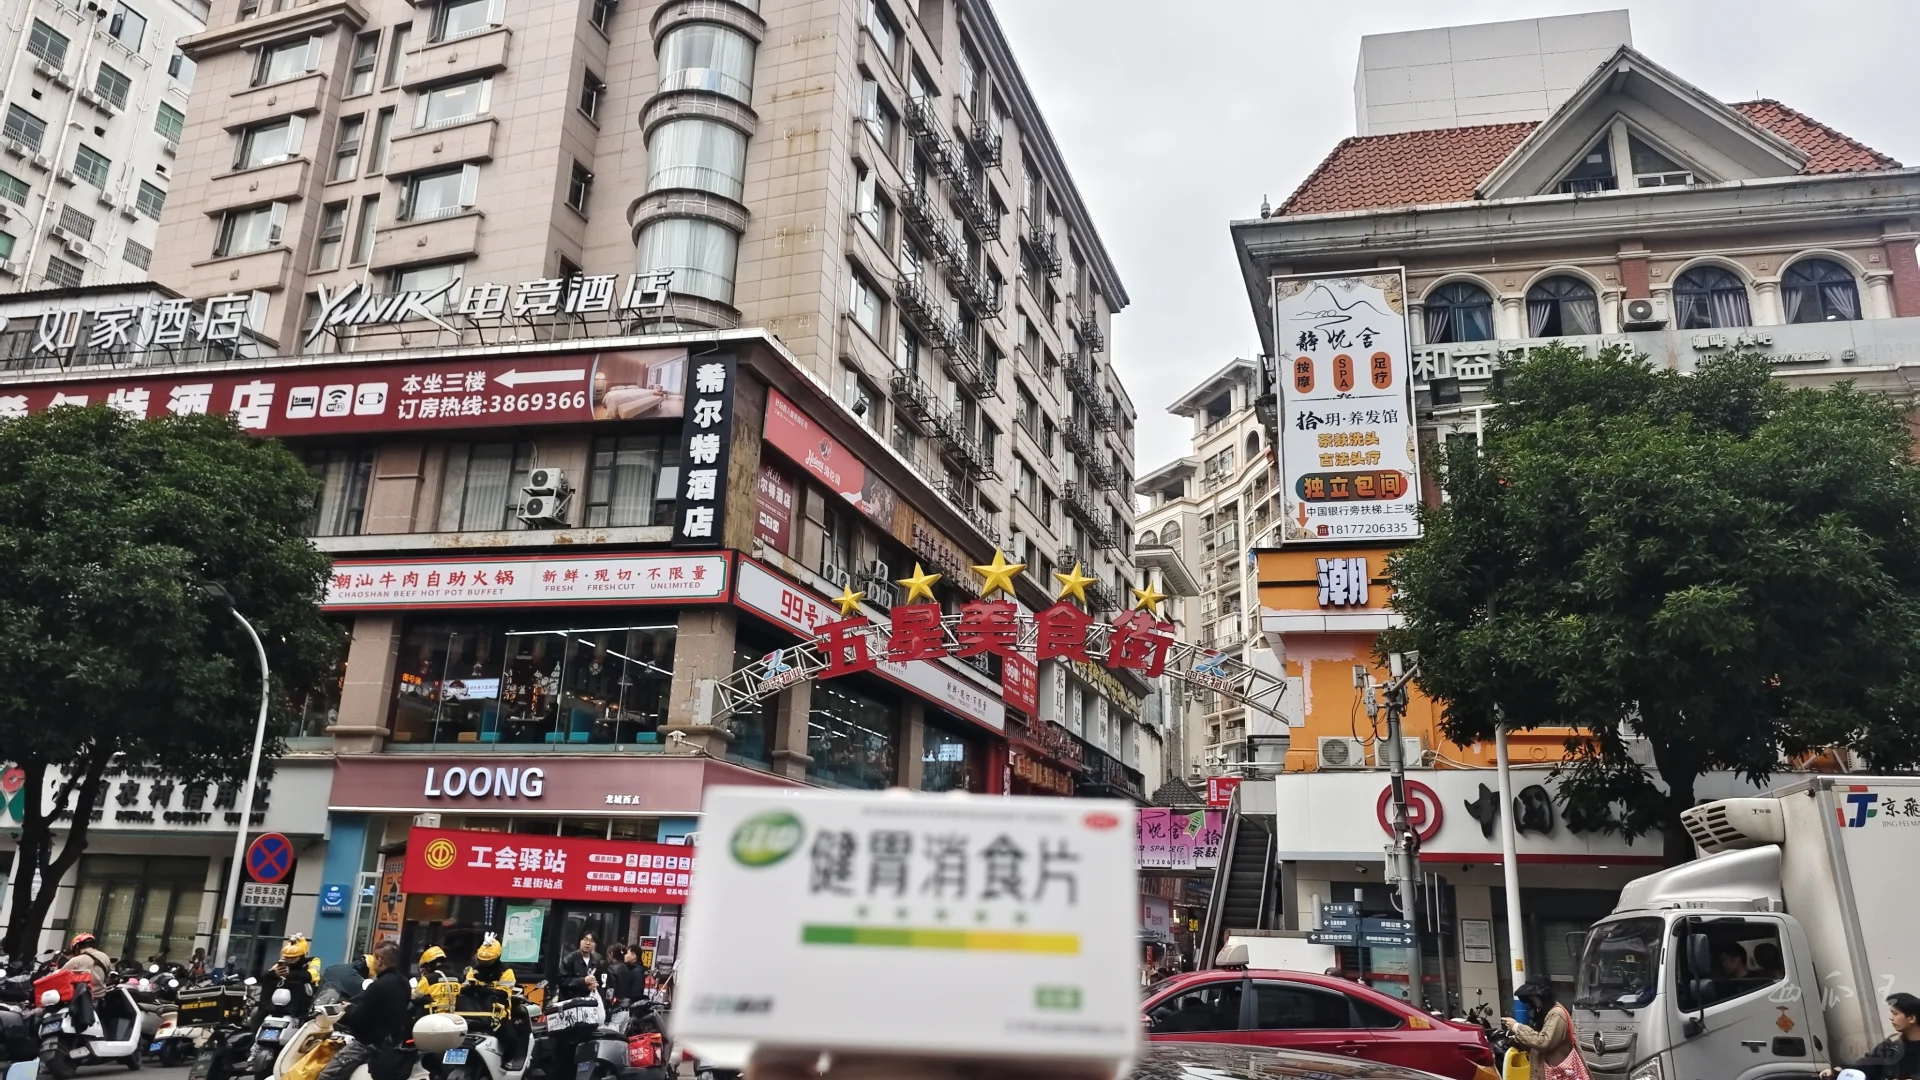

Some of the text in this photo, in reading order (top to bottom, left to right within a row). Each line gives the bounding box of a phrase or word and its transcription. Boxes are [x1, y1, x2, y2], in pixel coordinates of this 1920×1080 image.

[458, 270, 675, 320] 电竞酒店
[32, 293, 251, 353] 如家酒店
[1296, 327, 1380, 352] 静悦舍
[1692, 332, 1773, 349] 咖啡 餐吧
[1296, 362, 1314, 389] 按摩
[1338, 358, 1349, 389] SPA
[1373, 357, 1389, 385] 足疗
[402, 371, 486, 395] 本坐三楼
[397, 391, 586, 420] 订房热线:3869366
[683, 363, 726, 538] 希尔特酒店
[1317, 431, 1380, 448] 茶麸洗头
[1319, 450, 1381, 468] 古法头疗
[1303, 473, 1401, 499] 独立包间
[1306, 503, 1414, 518] 中国银行旁扶梯上三楼
[1330, 523, 1408, 535] 18177206335
[333, 569, 515, 589] 潮汕牛肉自助火锅
[542, 564, 707, 584] 新鲜·现切·不限量
[338, 591, 390, 599] CHAOSHAN
[393, 590, 417, 598] BEEF
[420, 589, 440, 597] HOT
[467, 588, 505, 596] BUFFET
[544, 581, 702, 592] FRESH FRESH CUT UNLIMITED
[780, 589, 818, 630] 99号
[813, 599, 1176, 679] 五星美食街
[1056, 668, 1064, 713] 采耳
[424, 766, 544, 798] LOONG
[605, 794, 641, 805] 龙城西点
[1882, 820, 1898, 828] JING
[467, 845, 567, 873] 工会驿站
[594, 855, 618, 863] 服务对象
[809, 828, 1082, 905] 健胃消食片
[512, 877, 563, 889] 五星街站点
[592, 872, 616, 880] 服务内容
[246, 885, 286, 896] 出租车及执
[585, 884, 657, 894] 开放时间:每日0:00-24:00
